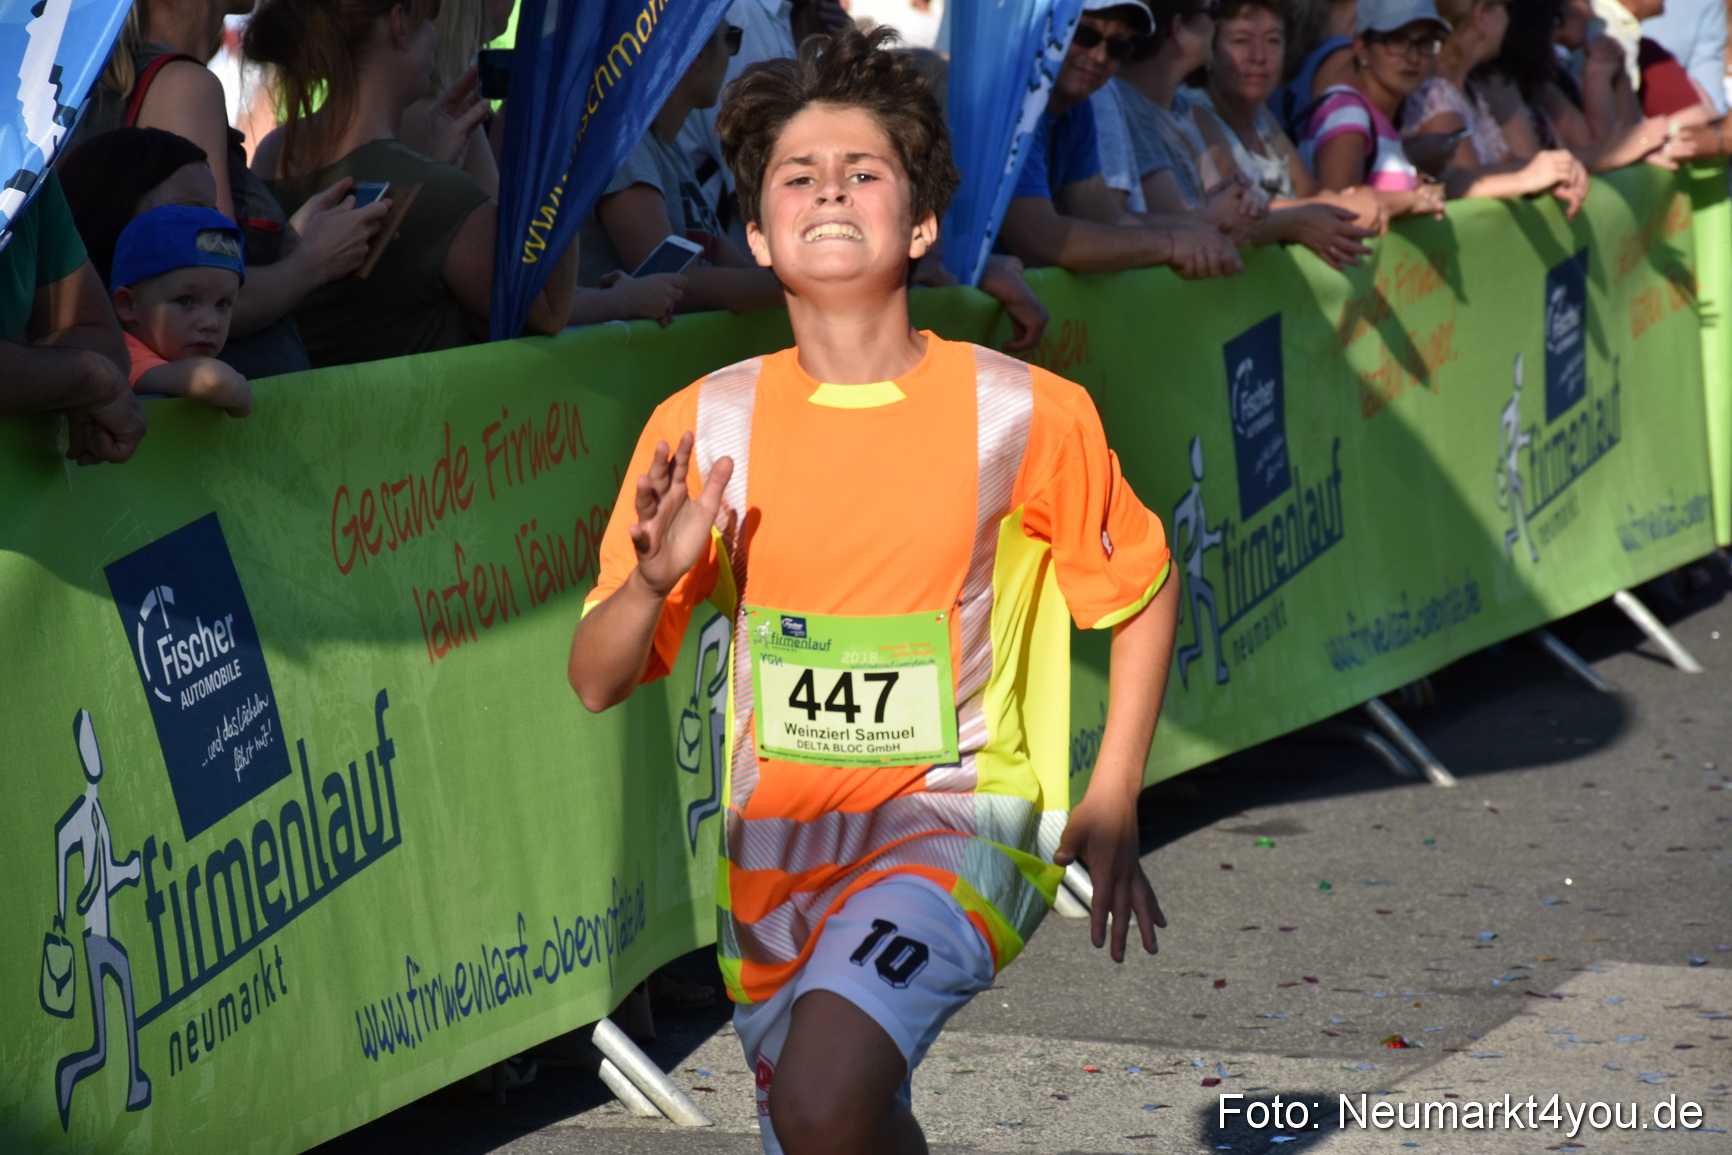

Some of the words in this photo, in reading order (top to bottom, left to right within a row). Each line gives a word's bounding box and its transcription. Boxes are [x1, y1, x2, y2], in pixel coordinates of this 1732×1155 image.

[332, 421, 474, 576] Gesunde
[482, 400, 590, 500] Firmen
[1222, 437, 1344, 620] firmenlauf
[413, 541, 520, 665] laufen
[156, 612, 235, 686] Fischer
[771, 632, 832, 652] firmenlauf
[841, 651, 878, 664] 2018
[181, 658, 242, 711] AUTOMOBILE
[788, 668, 899, 724] 447
[254, 718, 274, 751] mit!
[784, 722, 850, 741] Weinzierl
[855, 726, 915, 741] Samuel
[797, 739, 830, 752] DELTA
[833, 742, 863, 753] BLOC
[866, 743, 900, 753] GmbH
[144, 688, 402, 1003] firmenlauf
[850, 918, 929, 989] 10
[169, 943, 289, 1078] neumarkt
